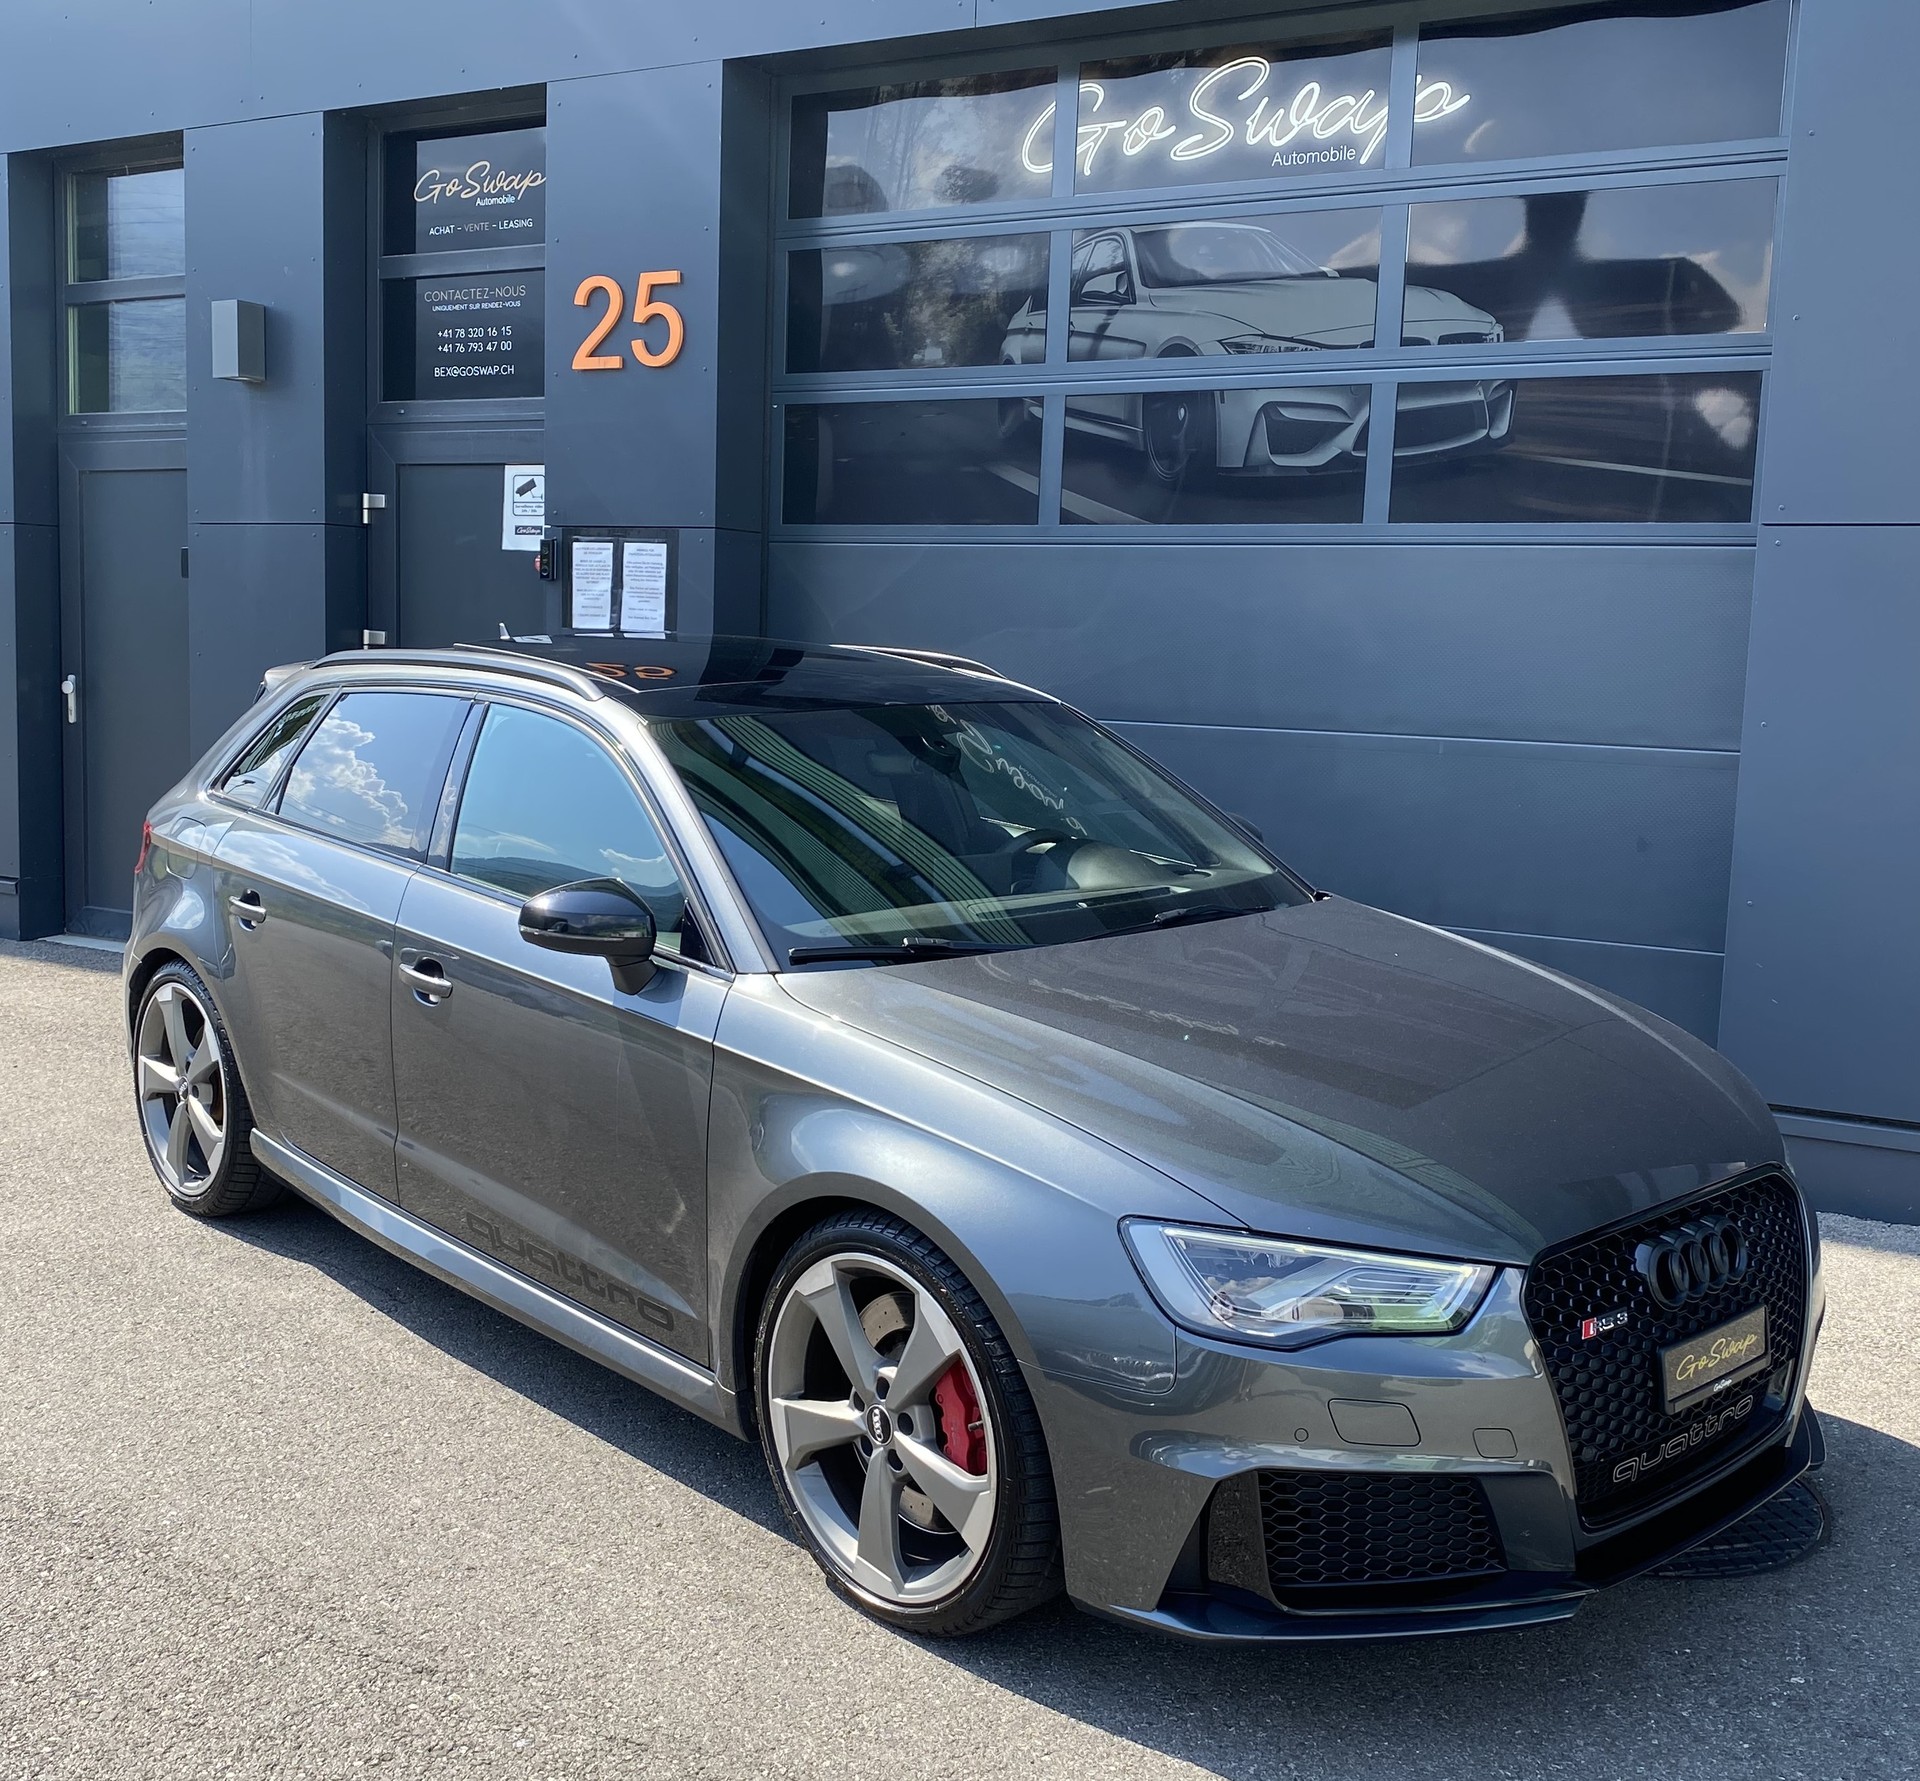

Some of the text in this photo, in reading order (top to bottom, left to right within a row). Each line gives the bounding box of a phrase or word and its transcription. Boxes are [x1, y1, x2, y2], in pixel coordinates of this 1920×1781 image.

[1271, 146, 1356, 167] Automobile
[413, 160, 547, 204] GoSwap
[476, 194, 516, 206] Automobile
[429, 225, 455, 236] ACHAT
[464, 222, 490, 233] VENTE
[499, 218, 533, 230] LEASING
[424, 285, 526, 302] CONTACTEZ-NOUS
[432, 300, 521, 312] UNIQUEMENT SUR RENDEZ-VOUS
[571, 270, 684, 370] 25
[438, 325, 512, 338] +41 78 320 16 15
[438, 340, 512, 353] +41 76 793 47 00
[434, 364, 515, 377] BEX@GOSWAP.CH
[466, 1211, 675, 1331] quattro
[1676, 1332, 1757, 1381] GoSwap
[1613, 1395, 1753, 1483] quattro
